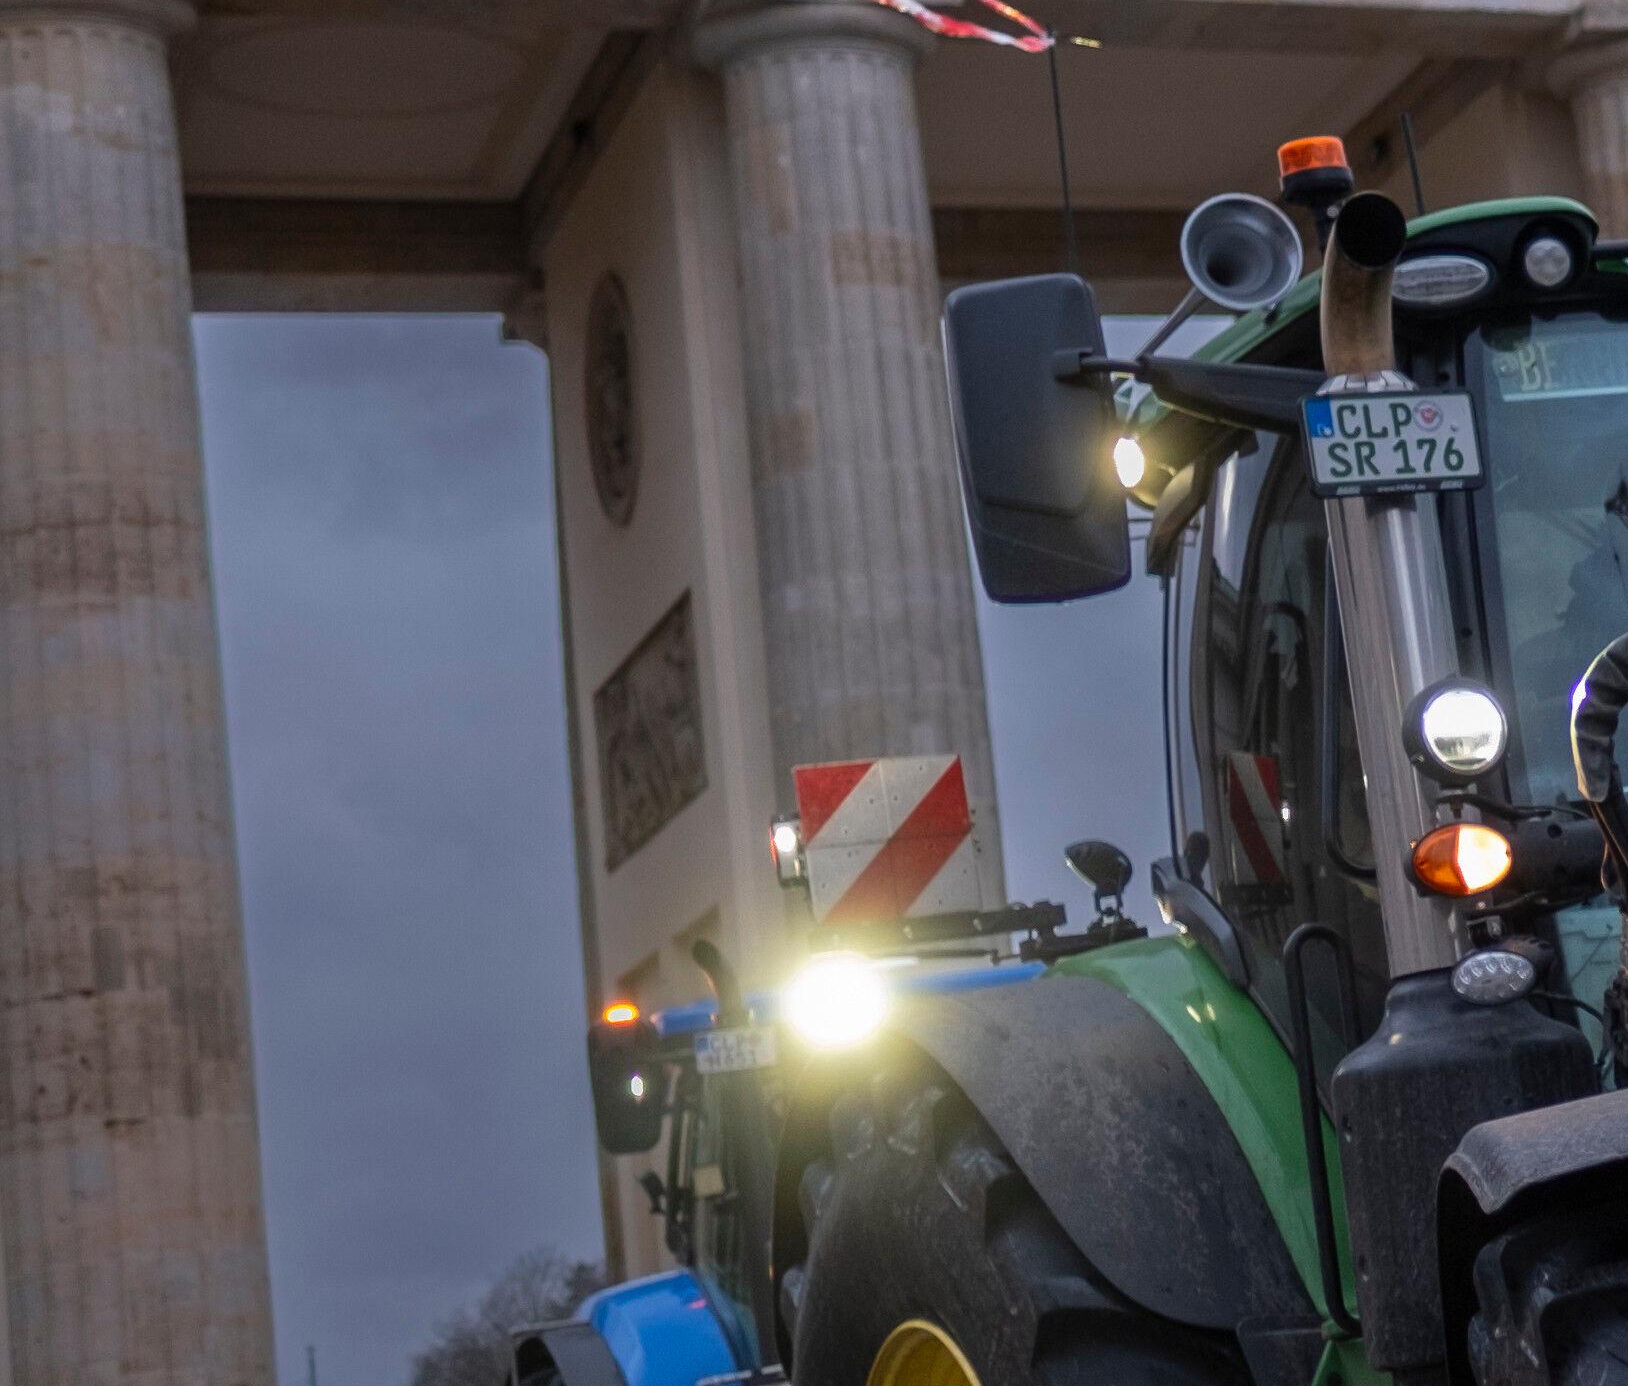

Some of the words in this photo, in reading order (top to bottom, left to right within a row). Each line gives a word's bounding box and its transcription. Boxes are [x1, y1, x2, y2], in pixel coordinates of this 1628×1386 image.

[1336, 402, 1413, 440] CLP
[1327, 441, 1381, 478] SR
[1392, 436, 1465, 474] 176
